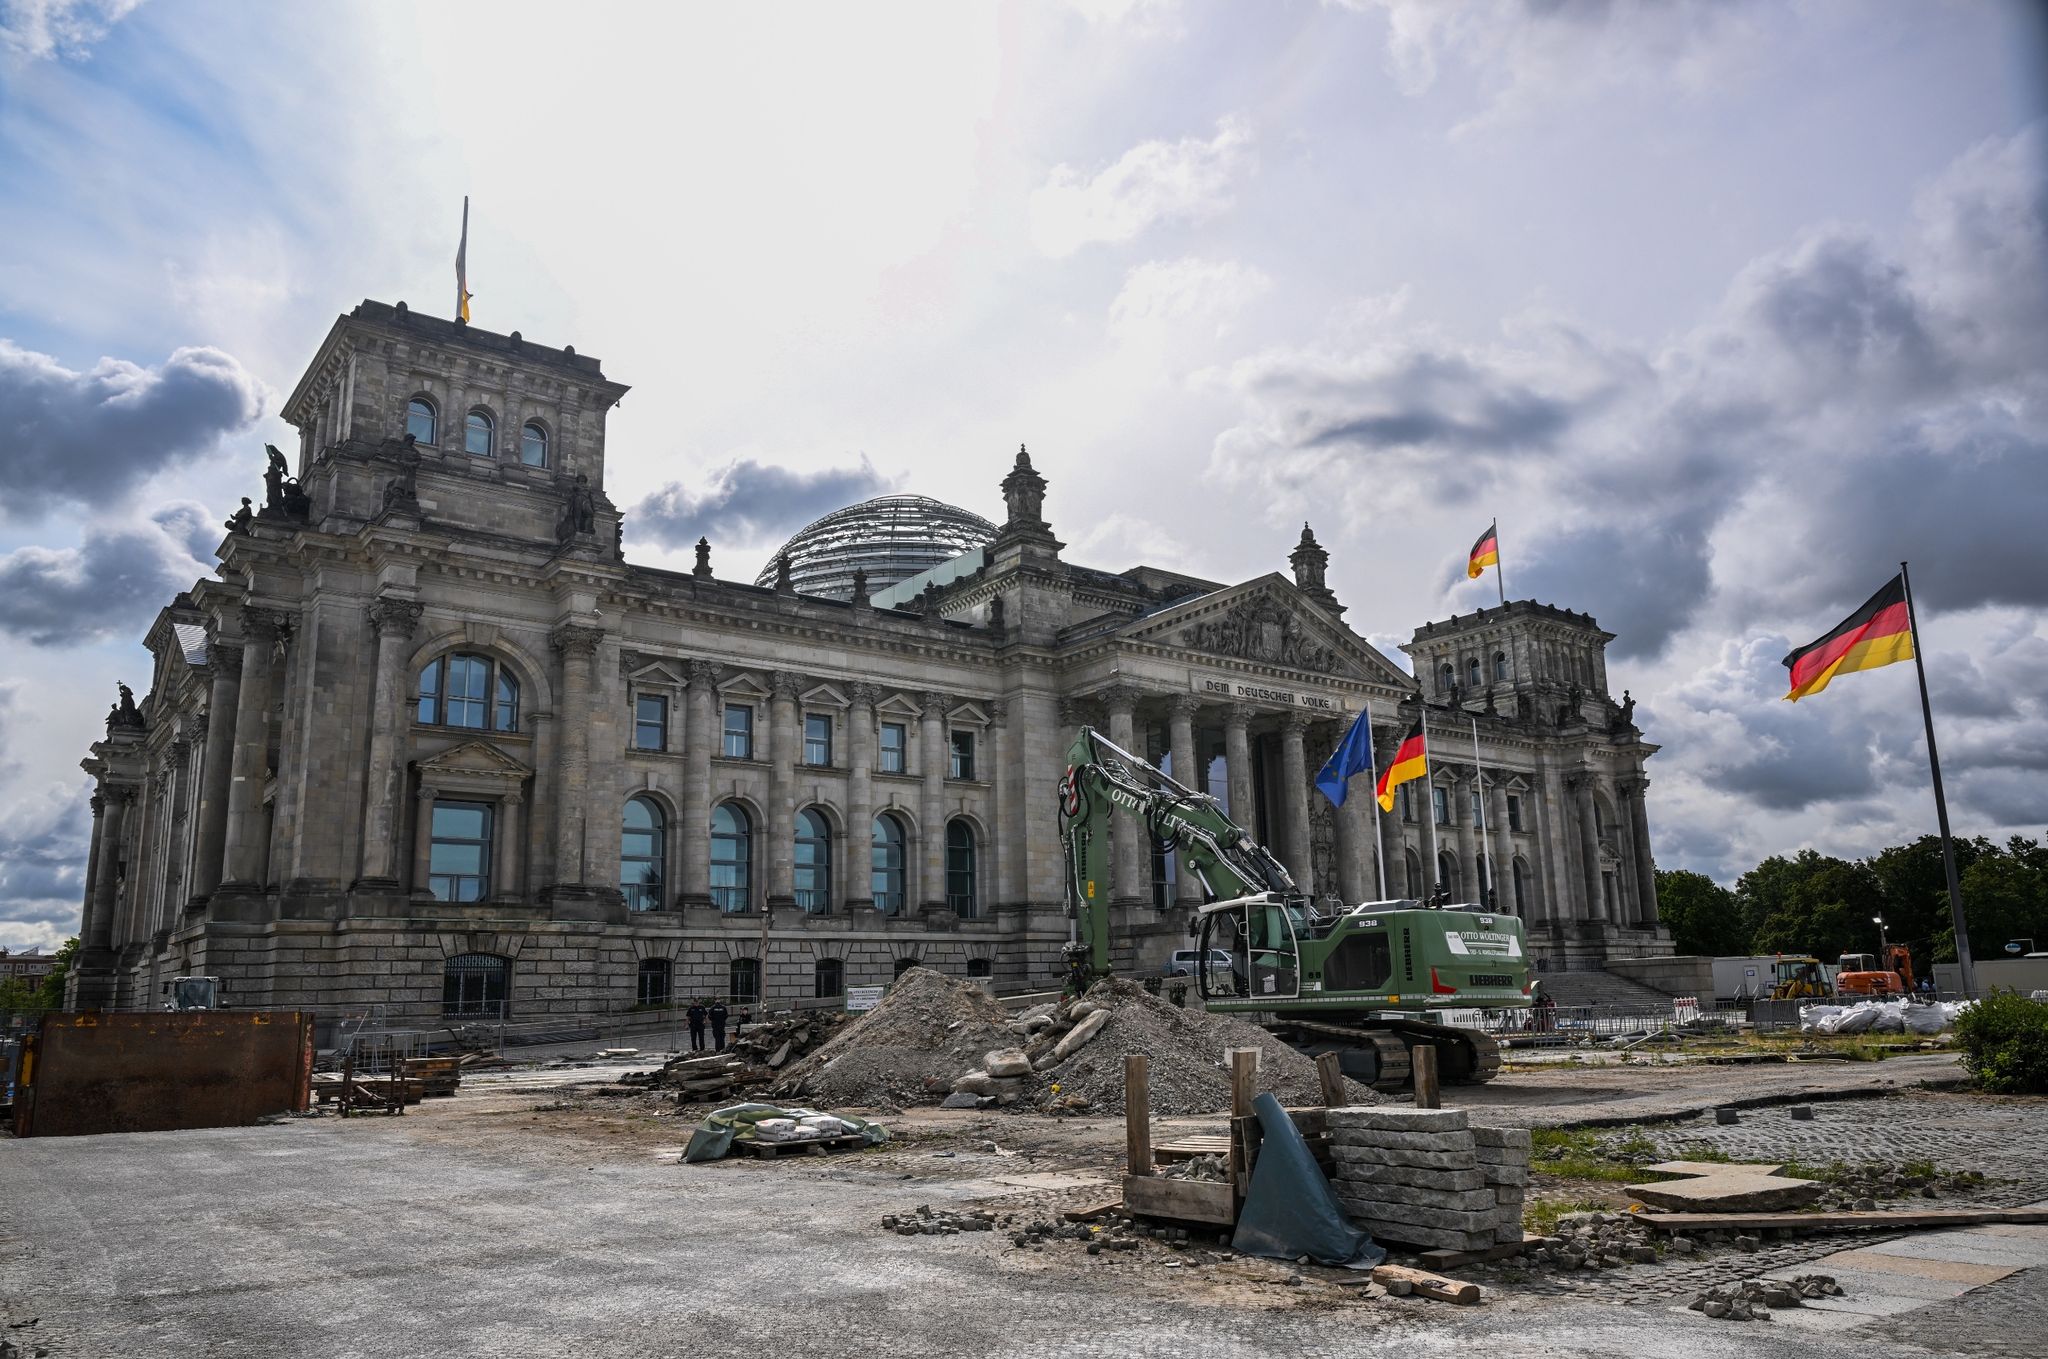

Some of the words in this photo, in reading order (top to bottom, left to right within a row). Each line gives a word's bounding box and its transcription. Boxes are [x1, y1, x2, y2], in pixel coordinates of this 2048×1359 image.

[1206, 681, 1230, 693] DEM
[1237, 686, 1295, 703] DEUTSCHEN
[1301, 696, 1330, 709] VOLKE
[1359, 919, 1378, 927] 938
[1460, 931, 1479, 940] OTTO
[1480, 931, 1511, 942] WÖLTINGER
[1403, 928, 1413, 981] LIEBHERR
[1470, 975, 1513, 987] LIEBHERR
